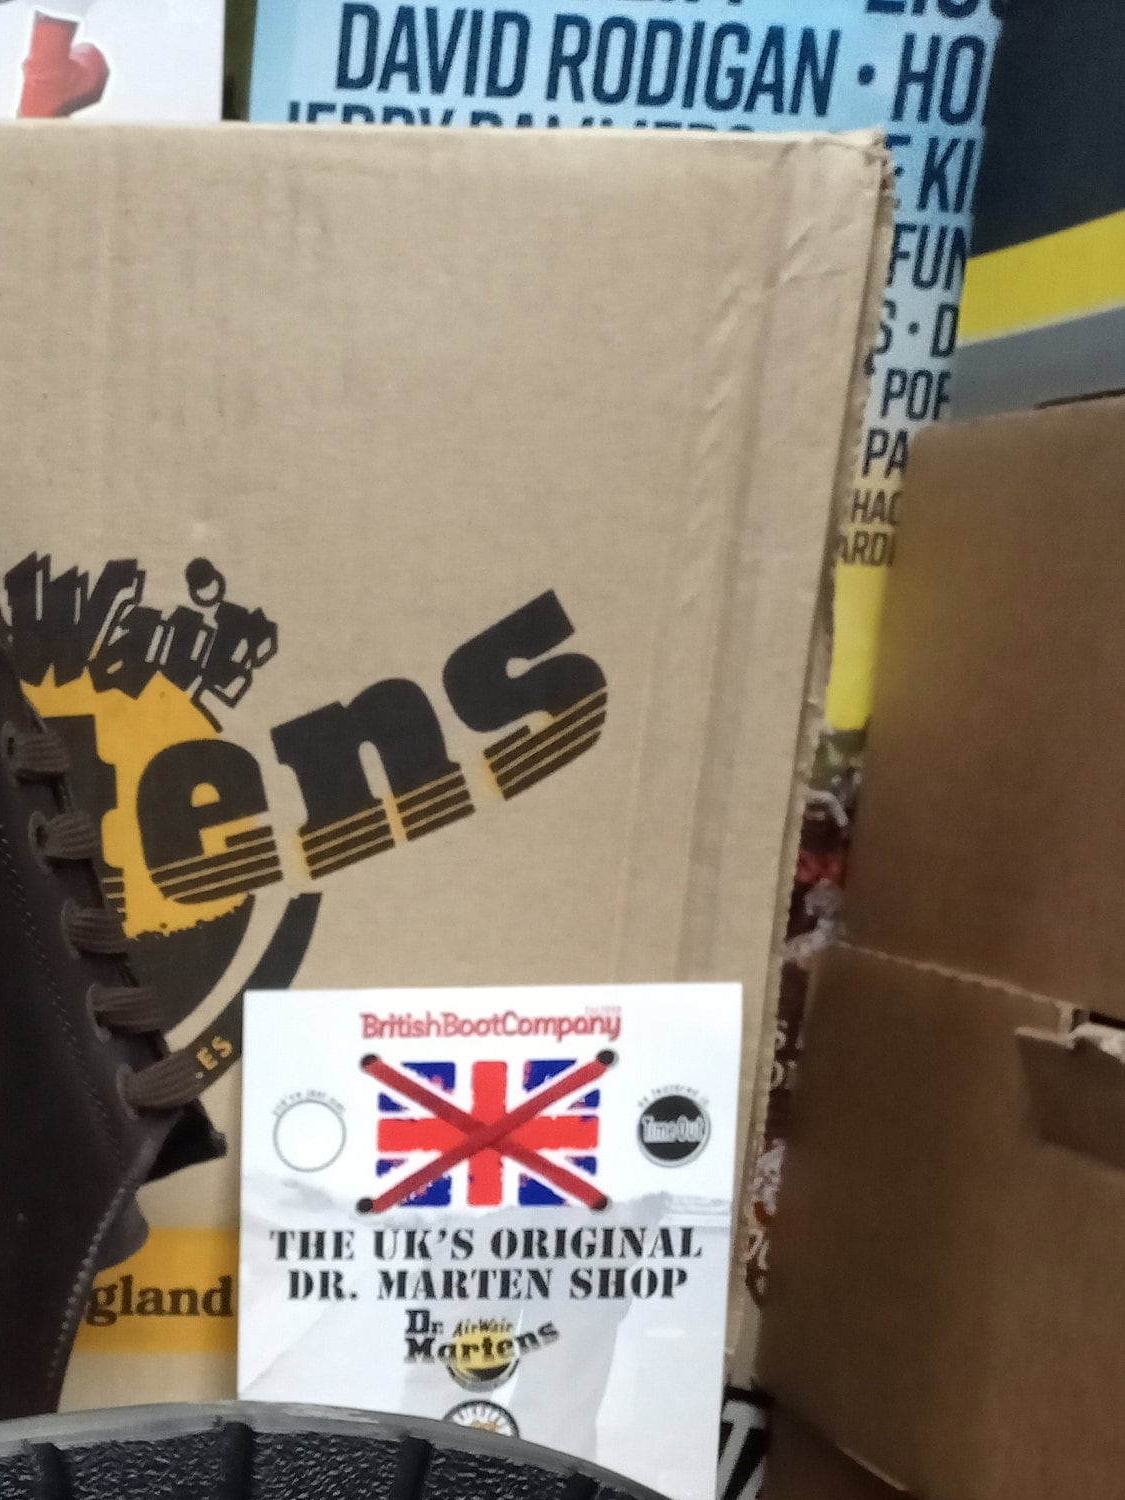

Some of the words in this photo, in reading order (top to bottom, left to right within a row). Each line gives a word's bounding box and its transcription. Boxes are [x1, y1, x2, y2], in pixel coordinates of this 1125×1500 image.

[335, 2, 532, 98] DAVID
[545, 12, 841, 118] RODIGAN
[268, 1229, 355, 1260] THE
[374, 1228, 475, 1260] UK'S
[490, 1226, 703, 1260] ORIGINAL
[288, 1268, 359, 1300] DR.
[376, 1267, 554, 1300] MARTEN
[569, 1266, 688, 1300] SHOP
[404, 1320, 560, 1363] Martens
